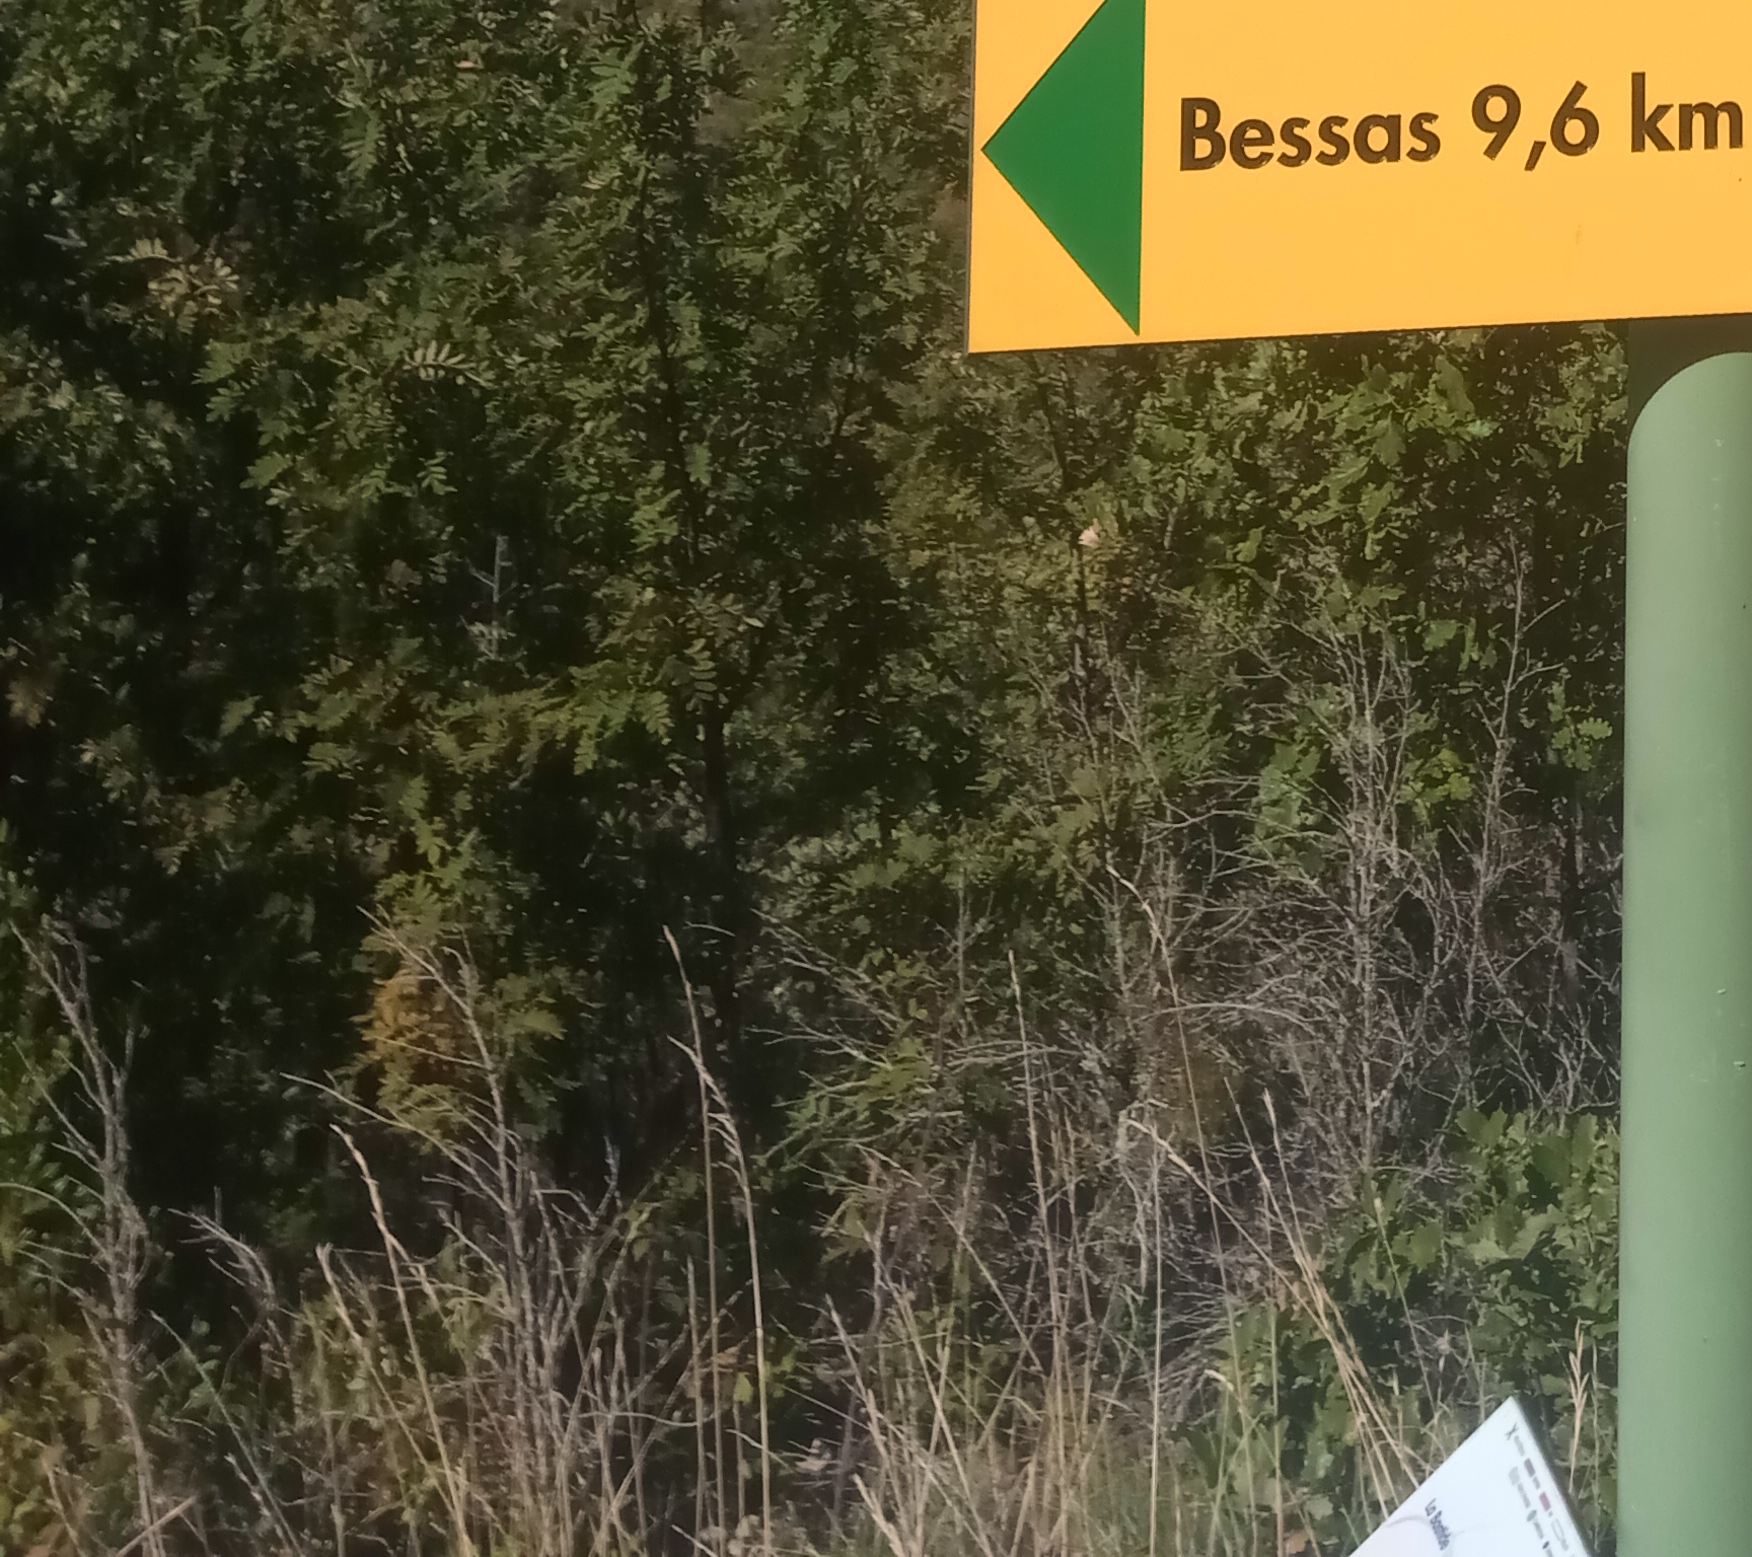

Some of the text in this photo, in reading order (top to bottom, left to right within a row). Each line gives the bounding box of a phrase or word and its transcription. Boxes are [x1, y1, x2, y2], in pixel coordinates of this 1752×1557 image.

[1180, 72, 1744, 172] Bessas 9,6 km
